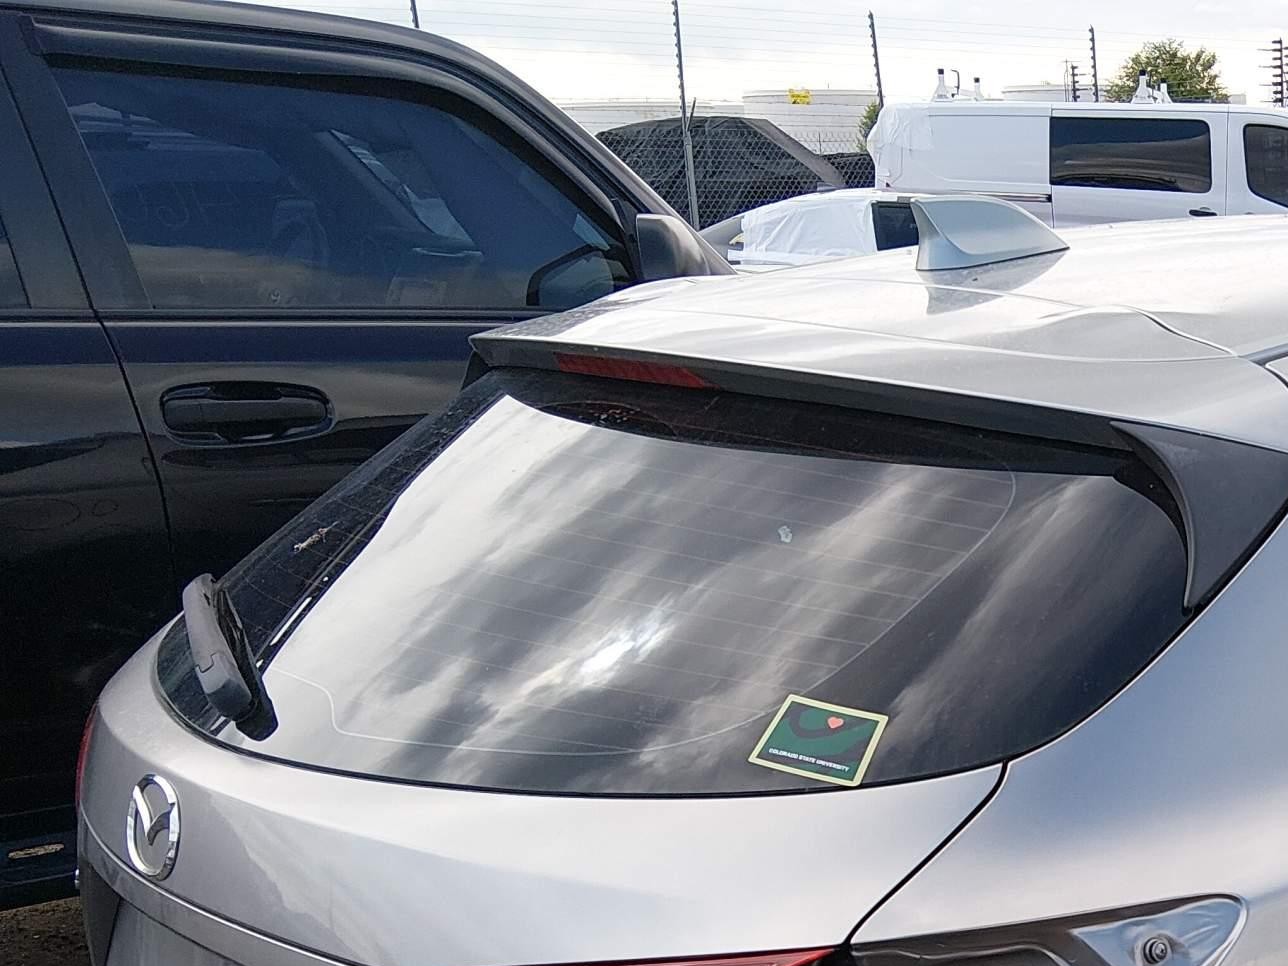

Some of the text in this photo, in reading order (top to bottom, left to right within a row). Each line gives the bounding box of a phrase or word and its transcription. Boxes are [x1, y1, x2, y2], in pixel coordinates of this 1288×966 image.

[768, 747, 850, 772] COLORADO STATE UNIVERSITY
